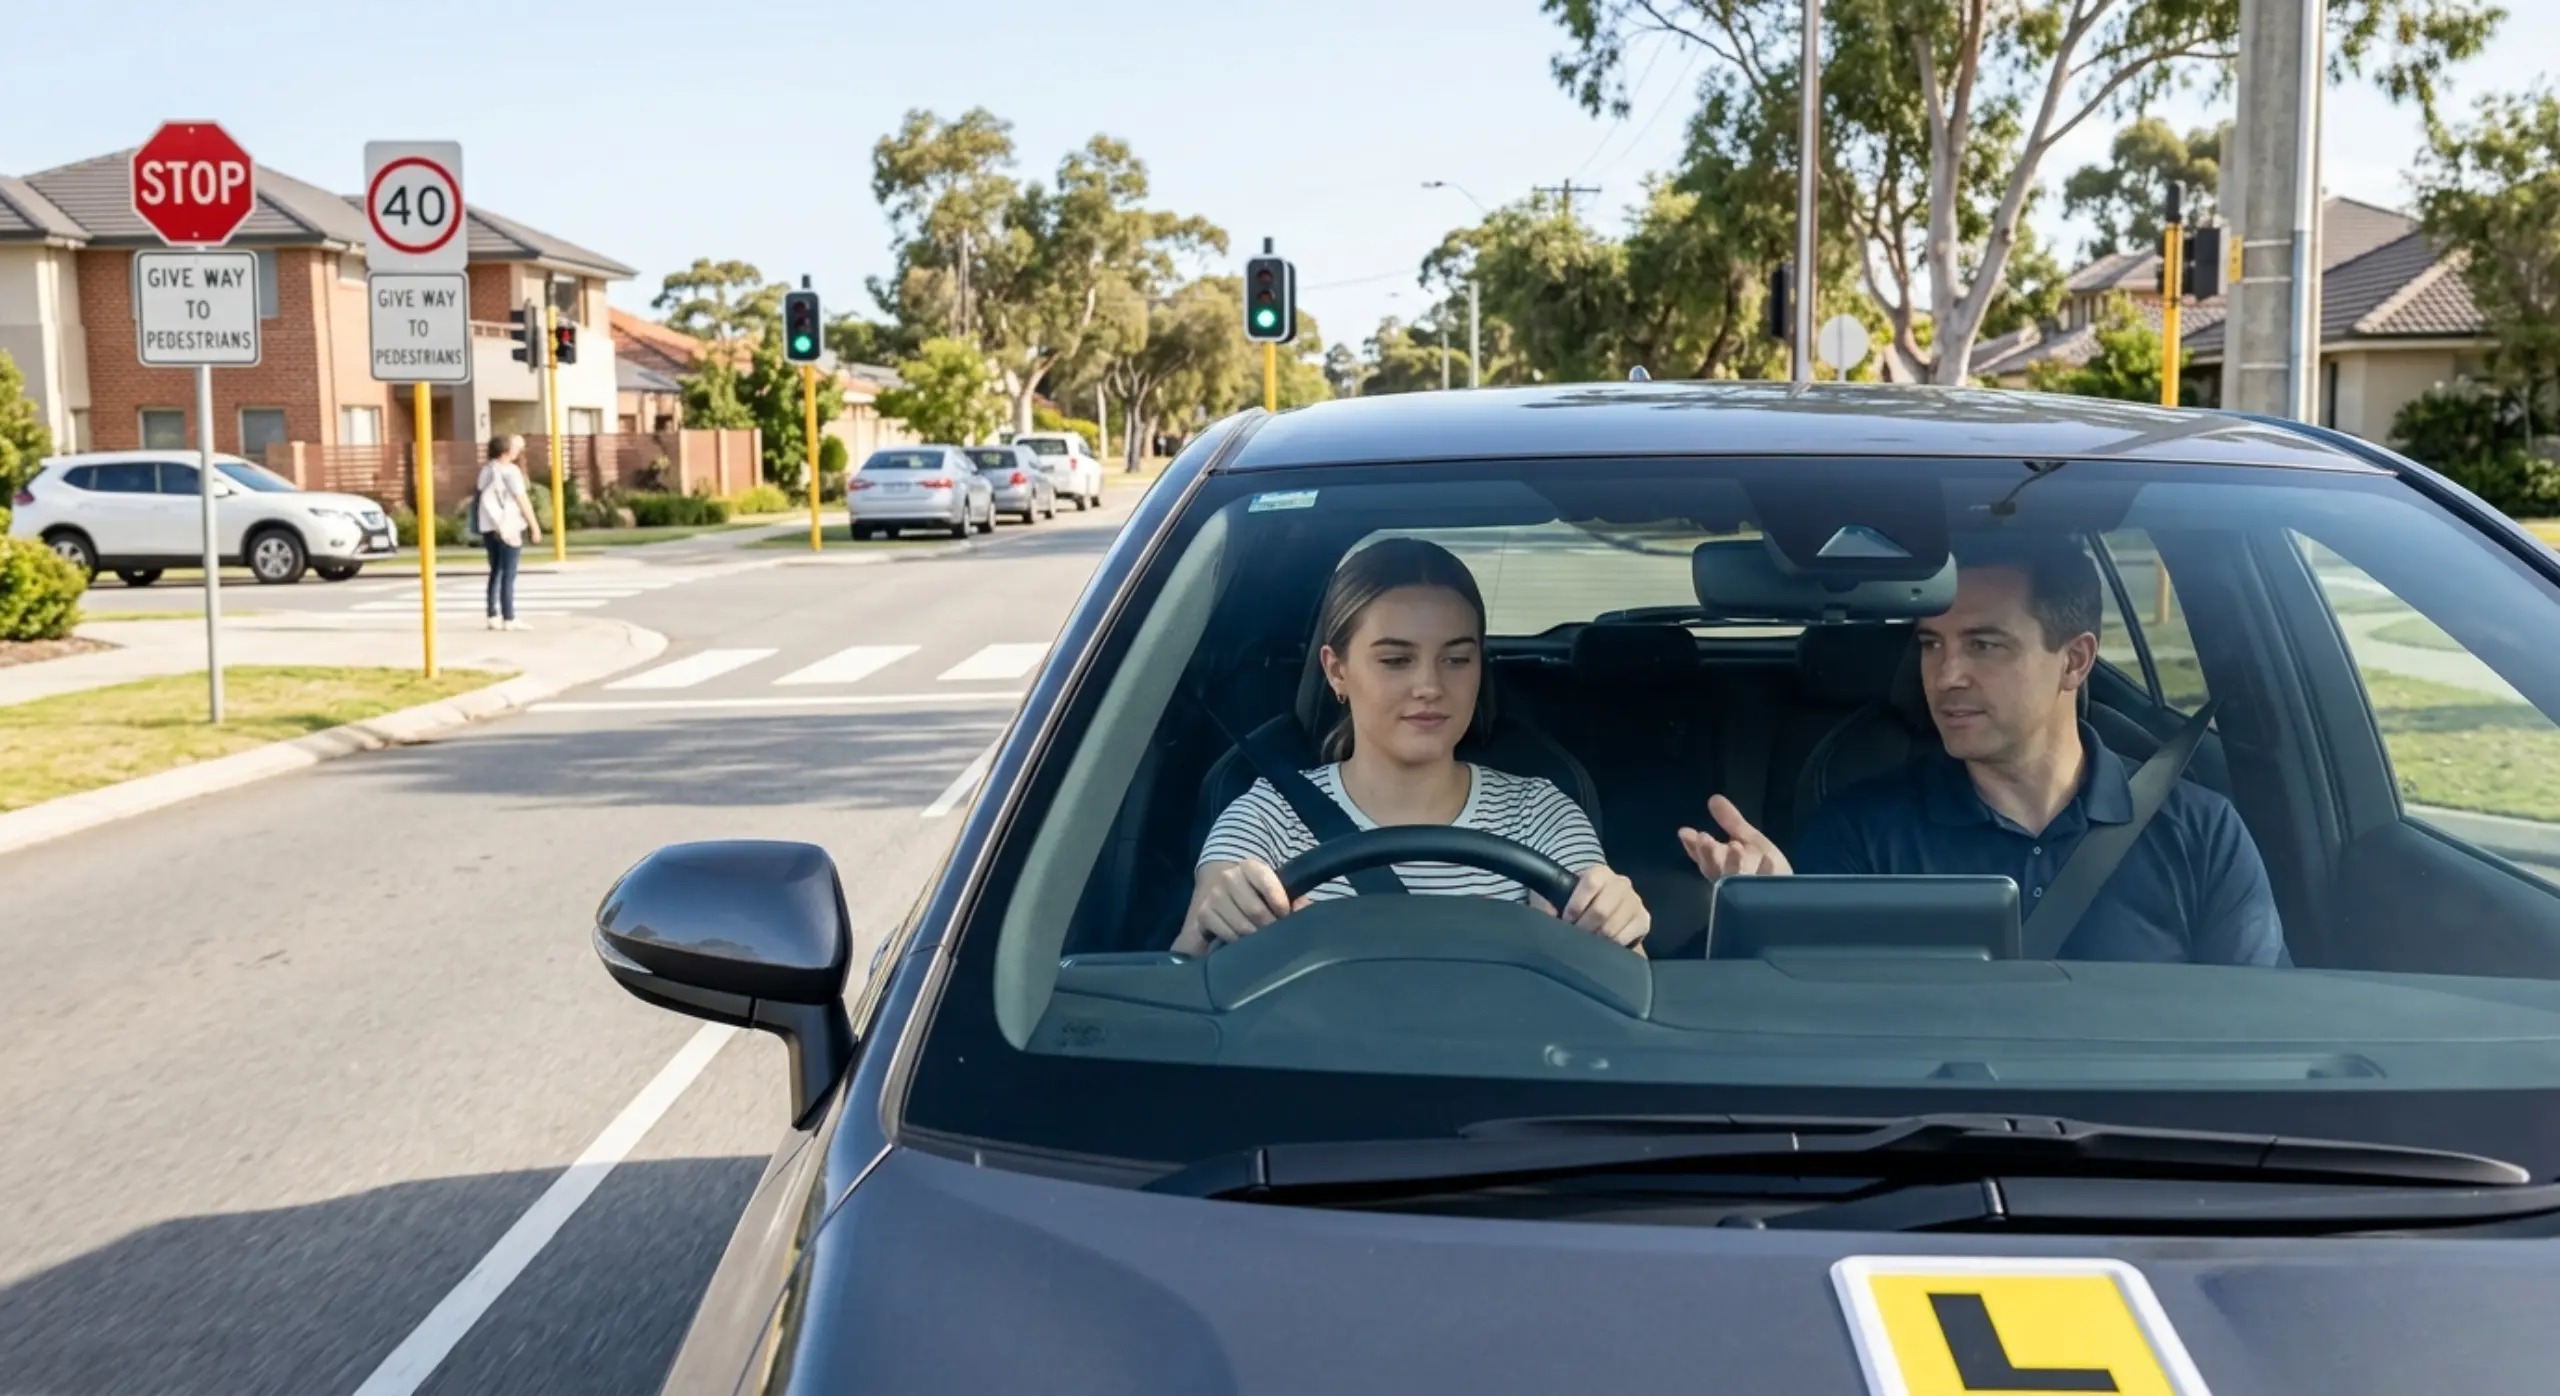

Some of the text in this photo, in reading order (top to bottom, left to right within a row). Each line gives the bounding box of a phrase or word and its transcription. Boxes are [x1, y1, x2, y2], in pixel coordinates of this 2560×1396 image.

[140, 160, 246, 205] STOP
[382, 185, 446, 227] 40
[148, 267, 246, 288] GIVE WAY
[377, 289, 456, 308] GIVE WAY
[185, 300, 211, 320] TO
[408, 319, 429, 337] TO
[146, 330, 251, 350] PEDESTRIANS
[375, 348, 463, 366] PEDESTRIANS
[1926, 1293, 2121, 1392] L
